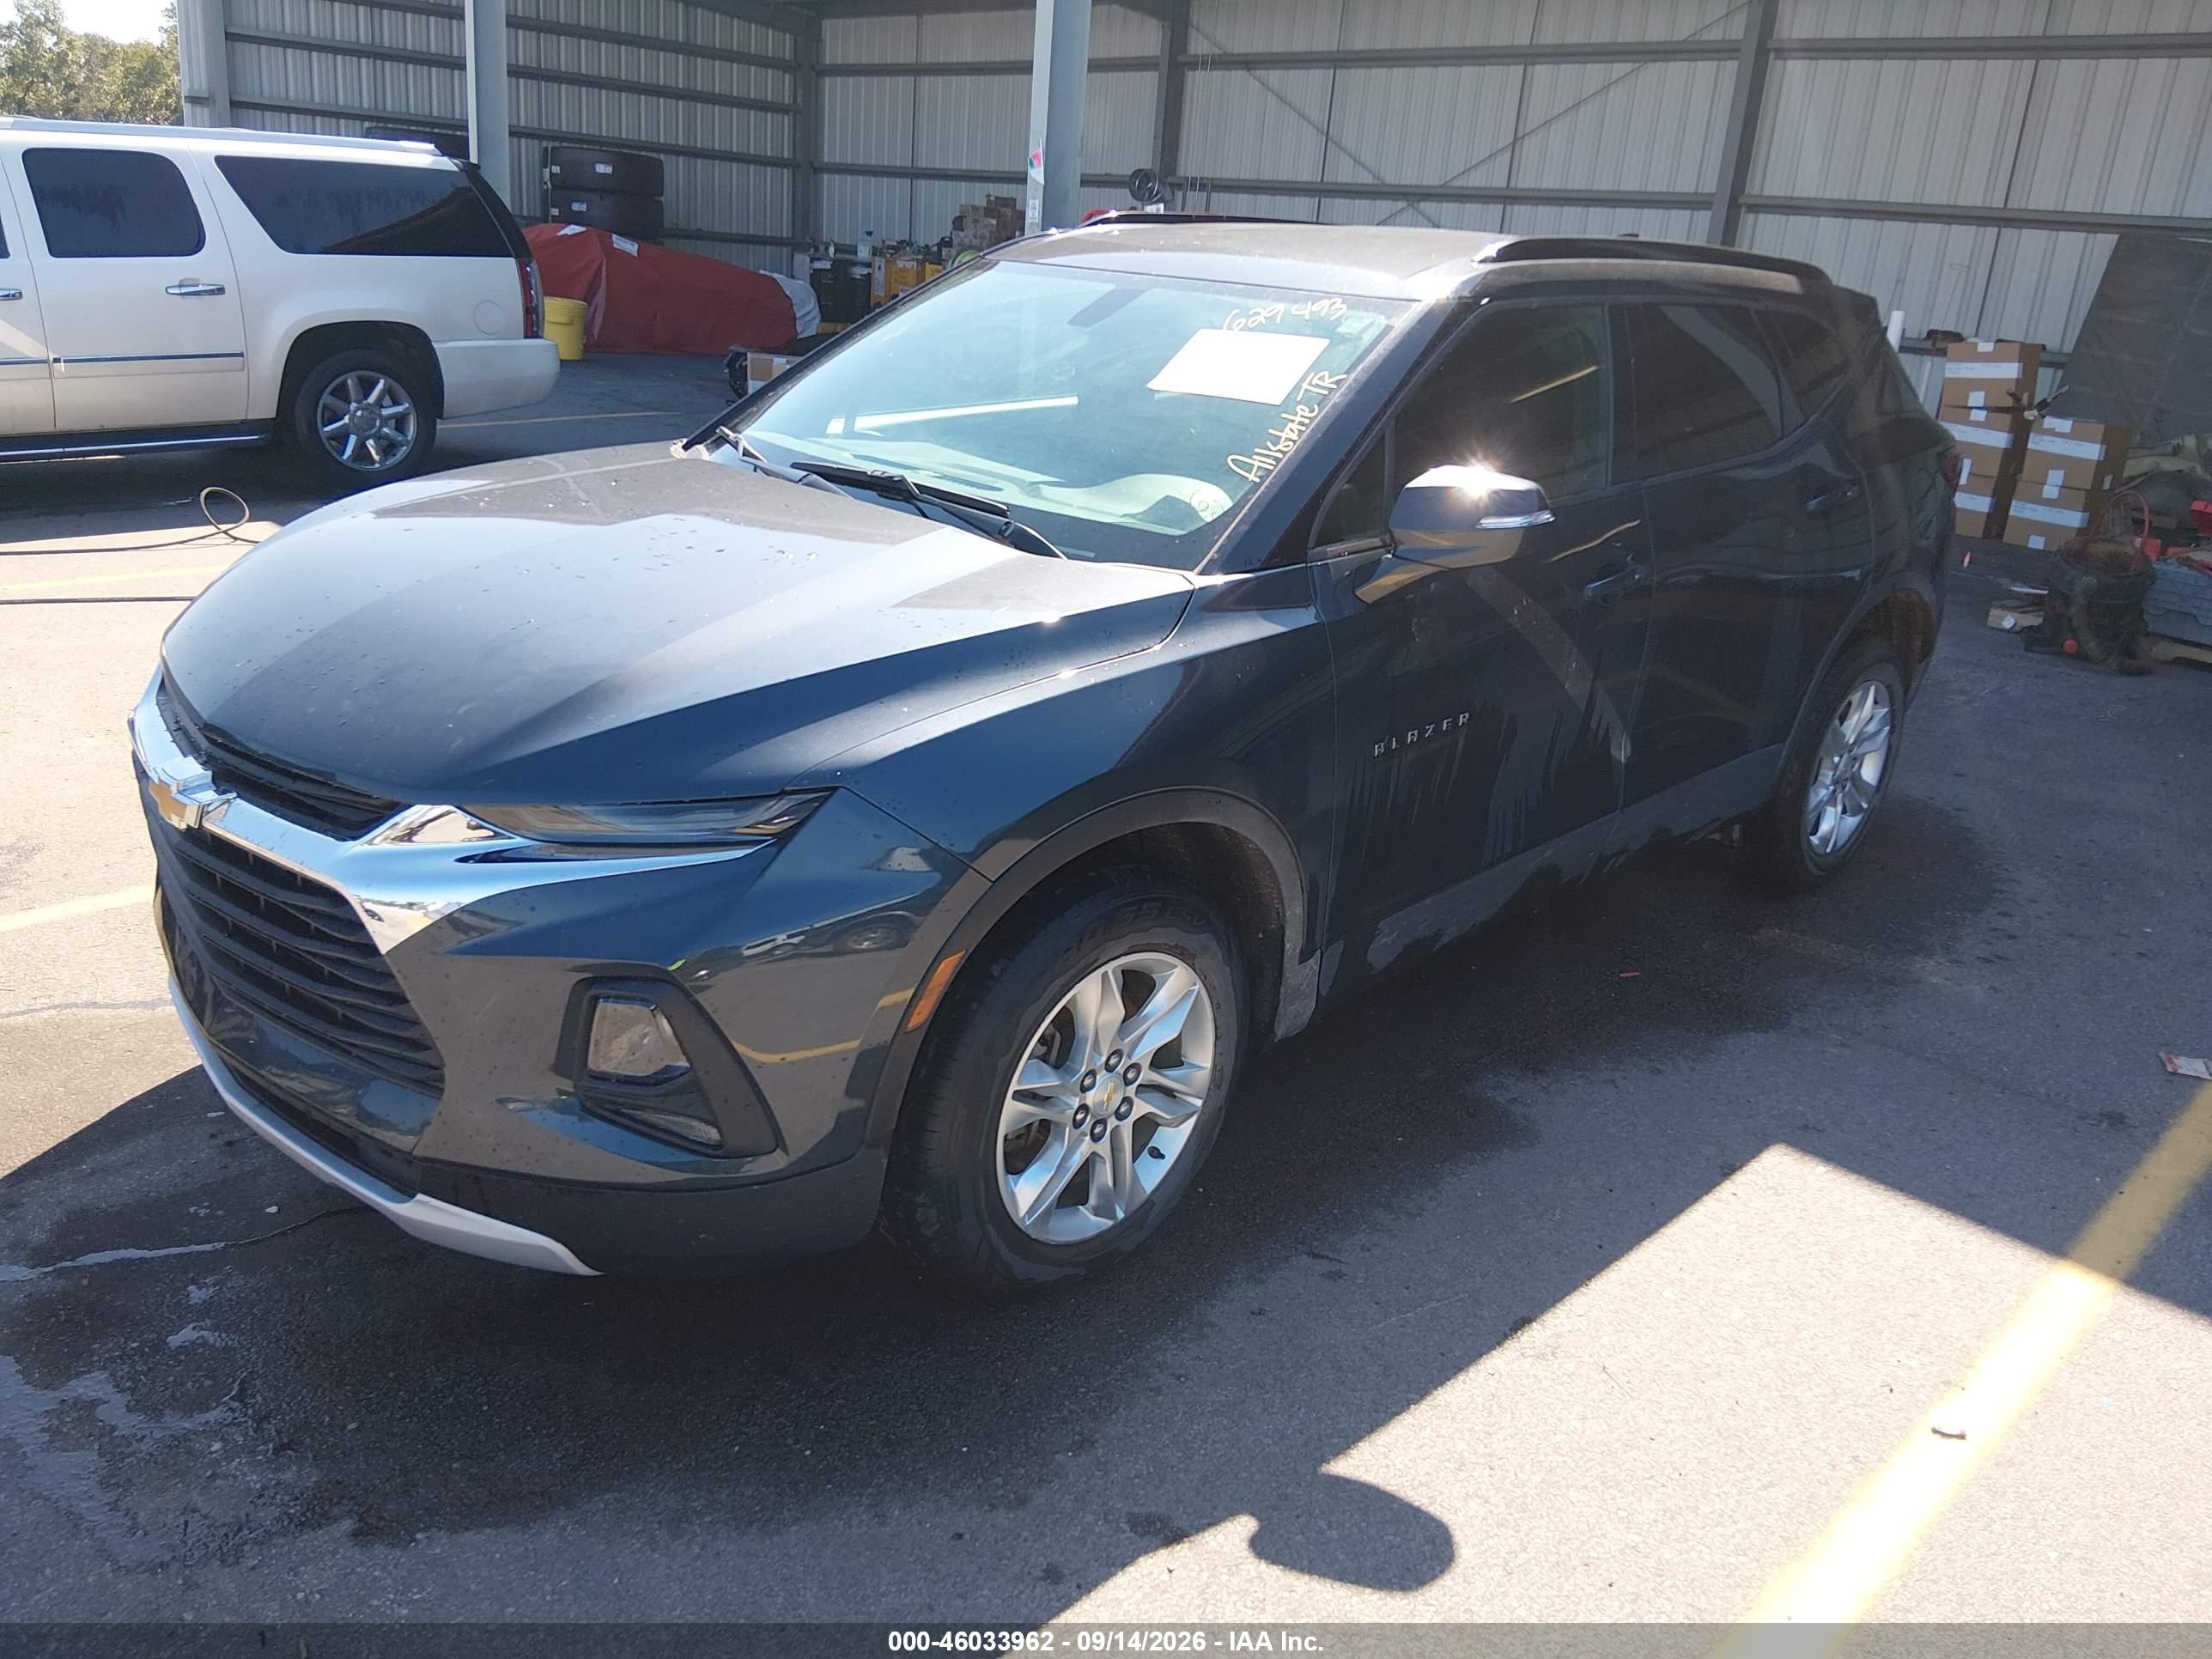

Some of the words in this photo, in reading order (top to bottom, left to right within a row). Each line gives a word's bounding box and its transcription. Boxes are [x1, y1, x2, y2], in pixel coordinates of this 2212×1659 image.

[1223, 302, 1285, 331] 629
[1291, 298, 1347, 321] 493
[1226, 404, 1320, 483] Allstate
[1296, 370, 1348, 402] TR
[1374, 712, 1469, 757] BLAZER
